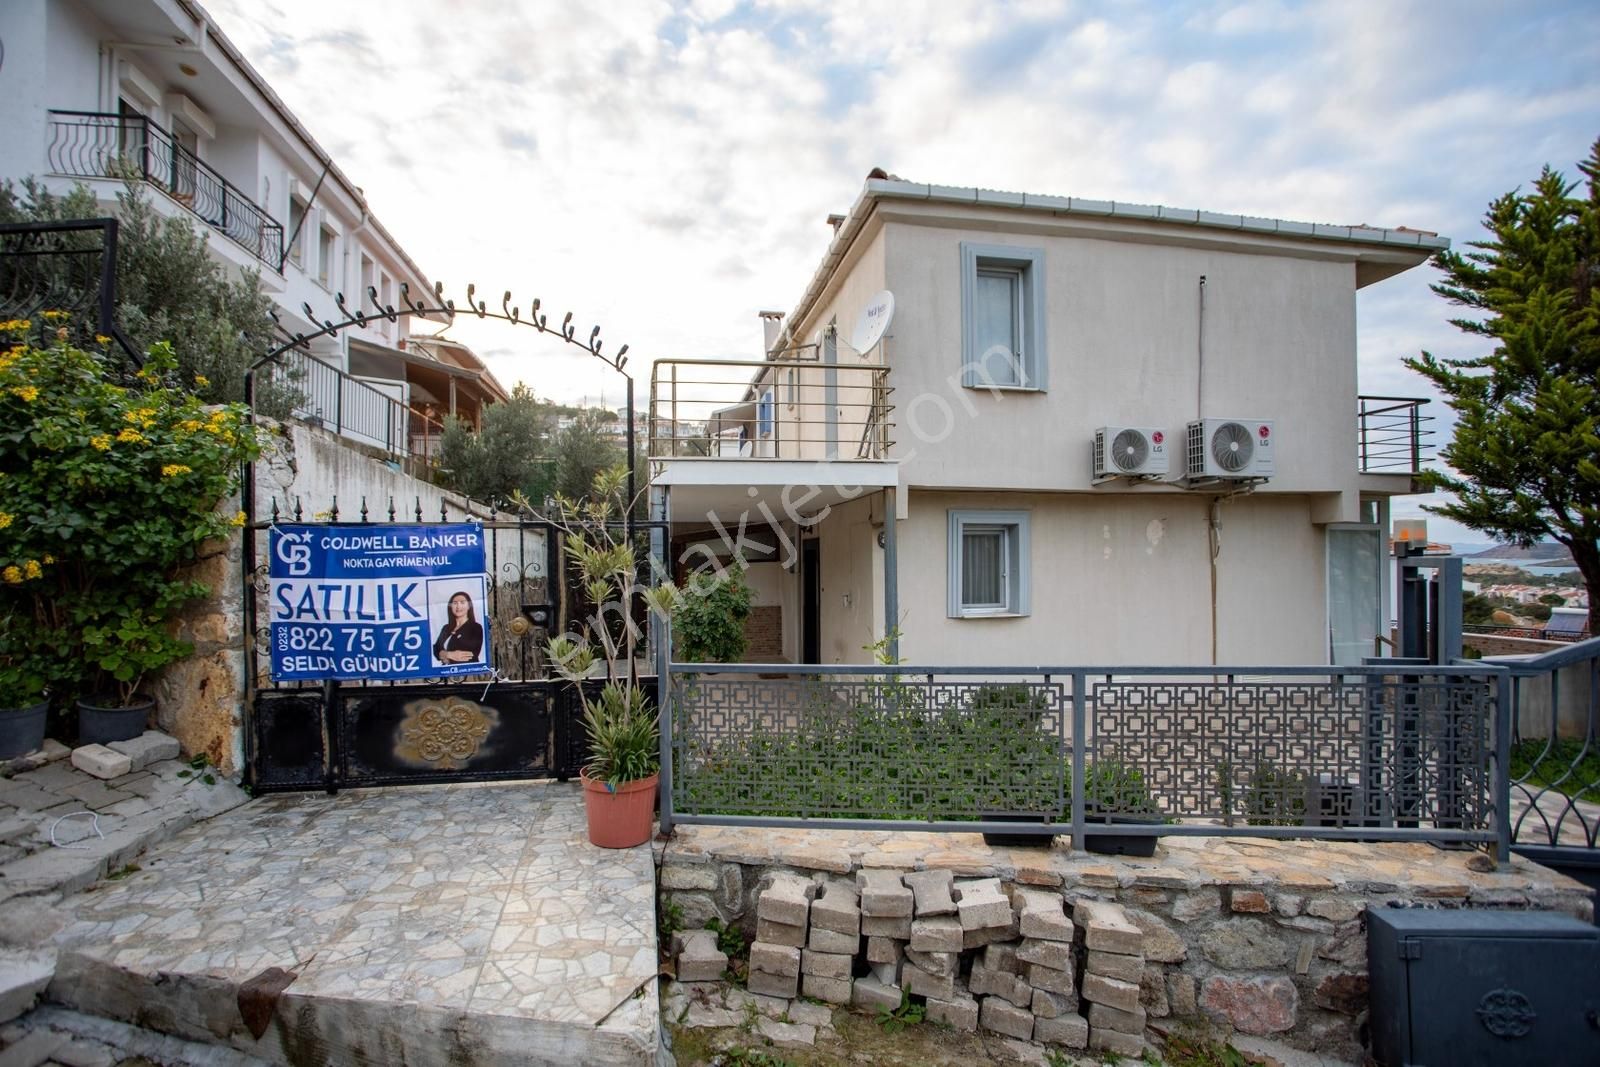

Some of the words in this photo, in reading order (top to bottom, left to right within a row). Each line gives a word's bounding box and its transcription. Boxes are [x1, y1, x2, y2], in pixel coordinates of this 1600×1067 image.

[321, 536, 403, 550] COLDWELL
[409, 534, 478, 548] BANKER
[343, 558, 374, 569] NOKTA
[376, 555, 452, 568] GAYRİMENKUL
[277, 582, 421, 621] SATILIK
[278, 626, 288, 651] 0232
[290, 626, 335, 652] 822
[341, 628, 376, 652] 75
[383, 626, 422, 652] 75
[282, 655, 337, 673] SELDA
[341, 653, 420, 673] GÜNDÜZ
